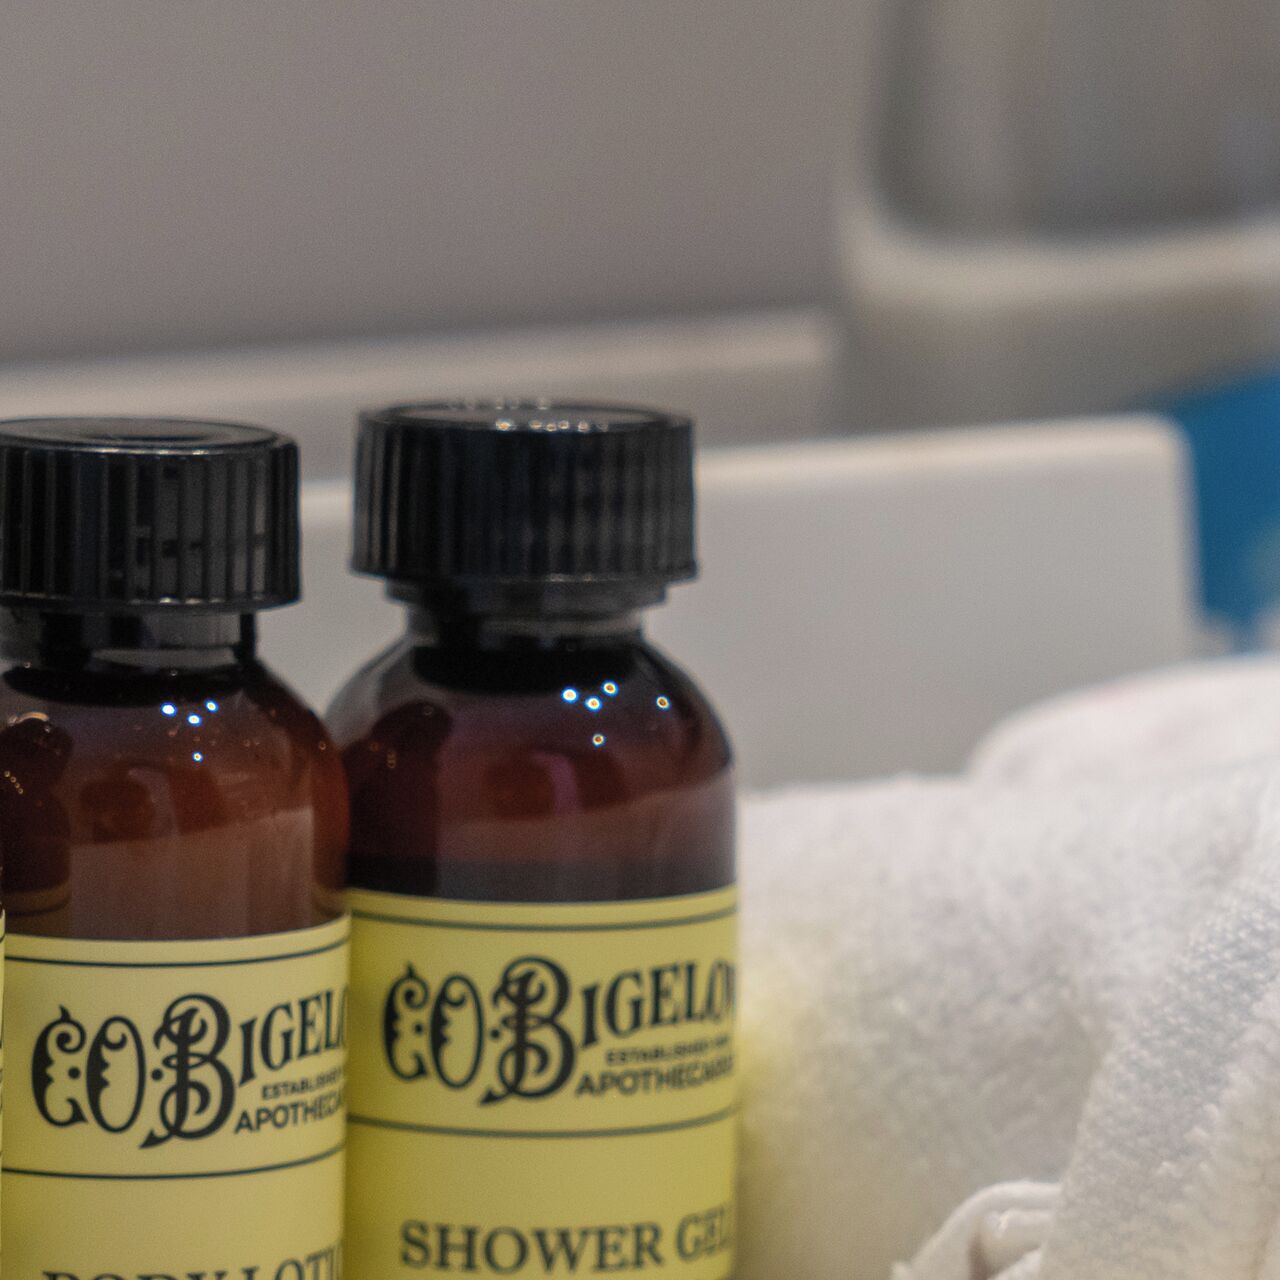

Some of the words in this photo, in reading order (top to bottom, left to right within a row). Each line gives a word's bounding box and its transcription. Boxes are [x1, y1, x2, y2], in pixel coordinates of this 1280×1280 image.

[139, 986, 347, 1149] BIGEL
[480, 954, 737, 1106] BIGELO
[400, 1220, 664, 1275] SHOWER
